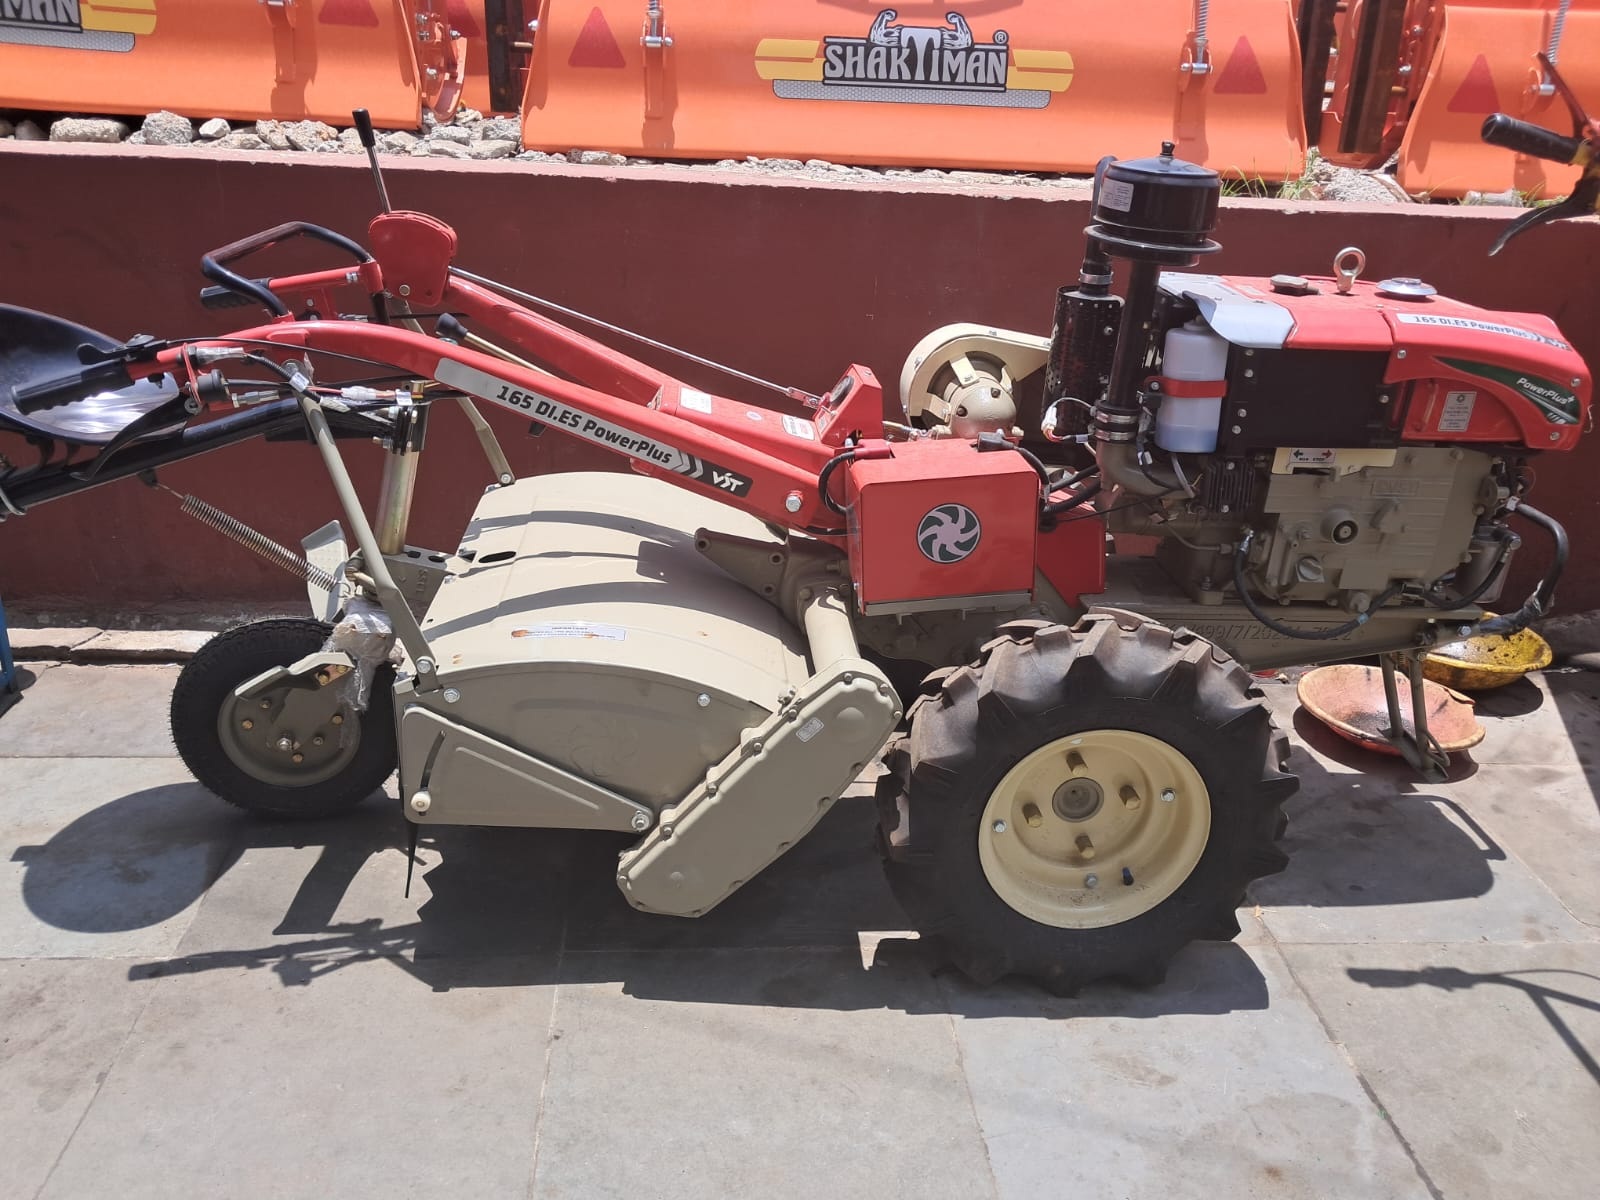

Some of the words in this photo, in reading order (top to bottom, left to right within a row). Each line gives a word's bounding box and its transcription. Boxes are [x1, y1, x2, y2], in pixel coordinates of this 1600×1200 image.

[824, 27, 1007, 84] SHAKTIMAN
[1415, 315, 1436, 324] 165
[496, 385, 534, 410] 165
[535, 400, 582, 428] DI.ES
[582, 419, 673, 465] PowerPlus
[712, 470, 745, 492] VST
